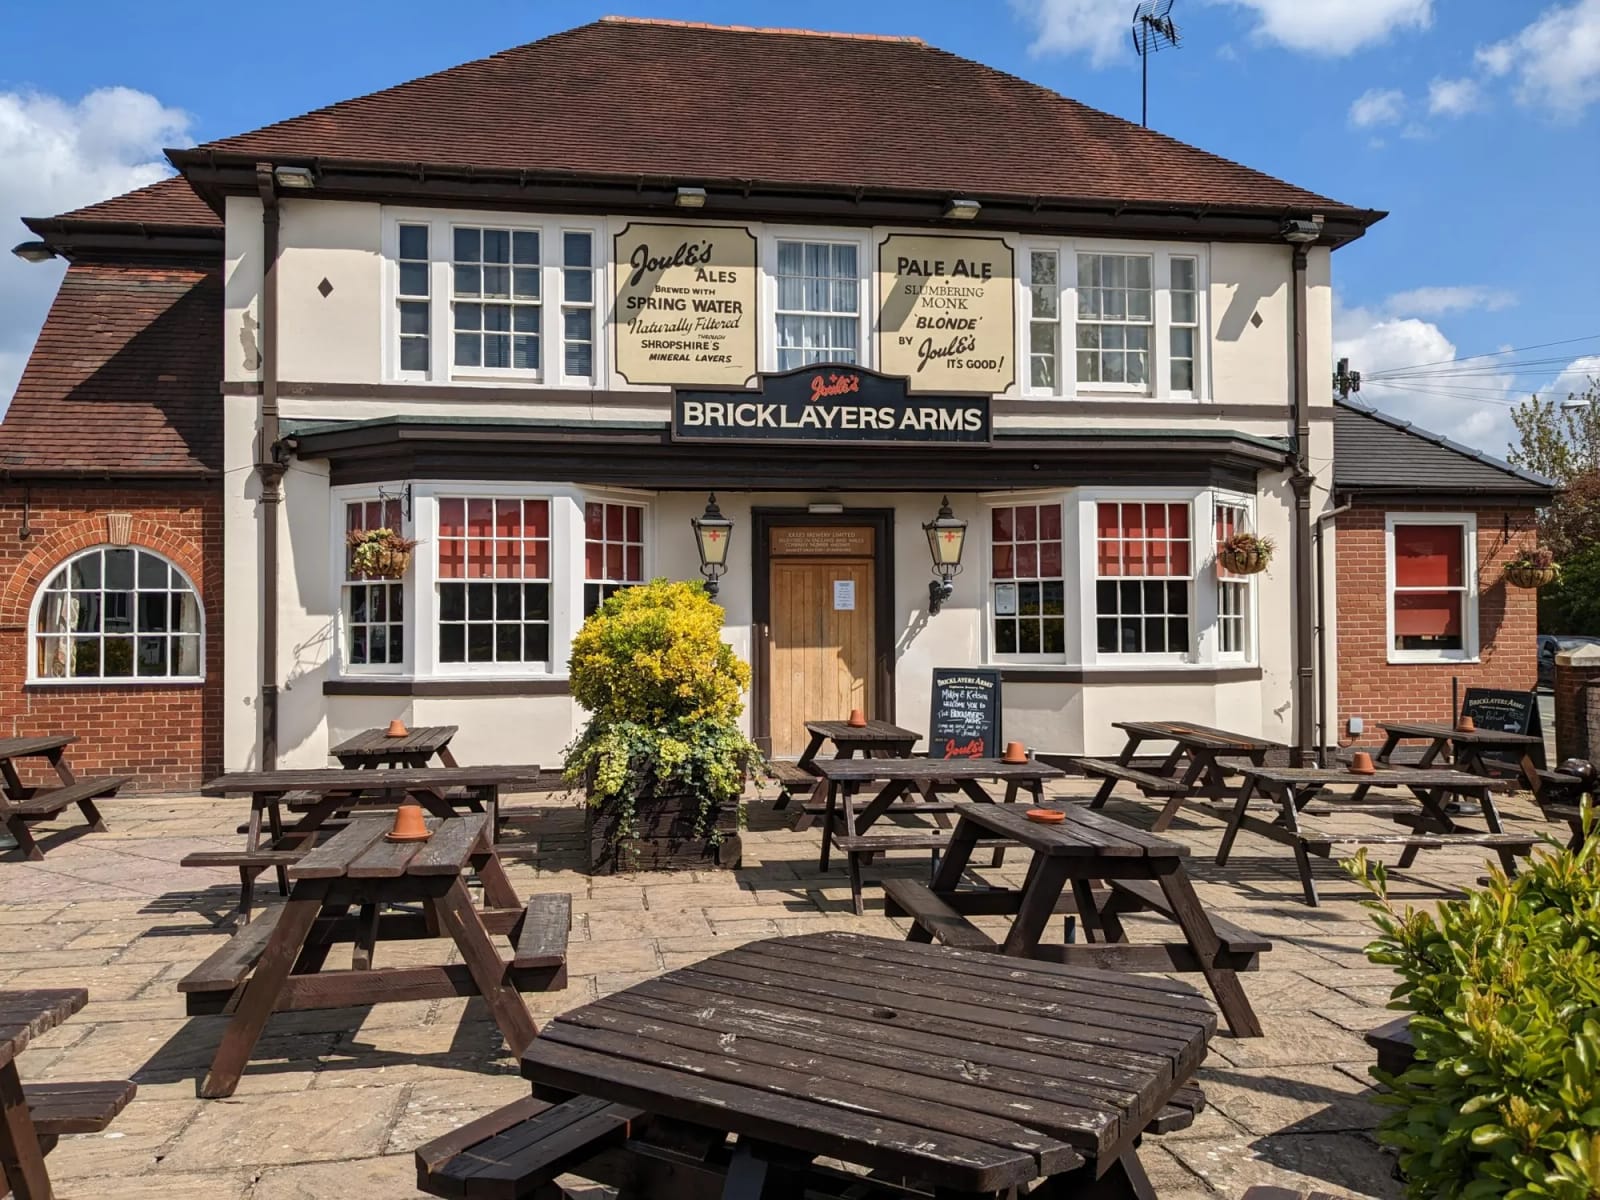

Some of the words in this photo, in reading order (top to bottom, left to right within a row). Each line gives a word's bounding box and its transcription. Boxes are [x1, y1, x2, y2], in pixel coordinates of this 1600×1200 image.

[898, 257, 944, 276] PALE
[952, 259, 991, 279] ALE
[696, 269, 736, 283] ALES
[655, 285, 690, 294] BREWED
[905, 285, 984, 298] SLUMBERING
[626, 296, 686, 310] SPRING
[693, 300, 743, 314] WATER
[922, 297, 968, 310] MONK
[628, 318, 693, 336] Naturally
[695, 315, 742, 331] Filtered
[641, 340, 719, 351] SHROPSHIRE'S
[899, 337, 913, 345] BY
[649, 353, 690, 362] MINERAL
[696, 354, 732, 363] LAYERS
[683, 401, 894, 430] BRICKLAYERS
[899, 408, 982, 432] ARMS
